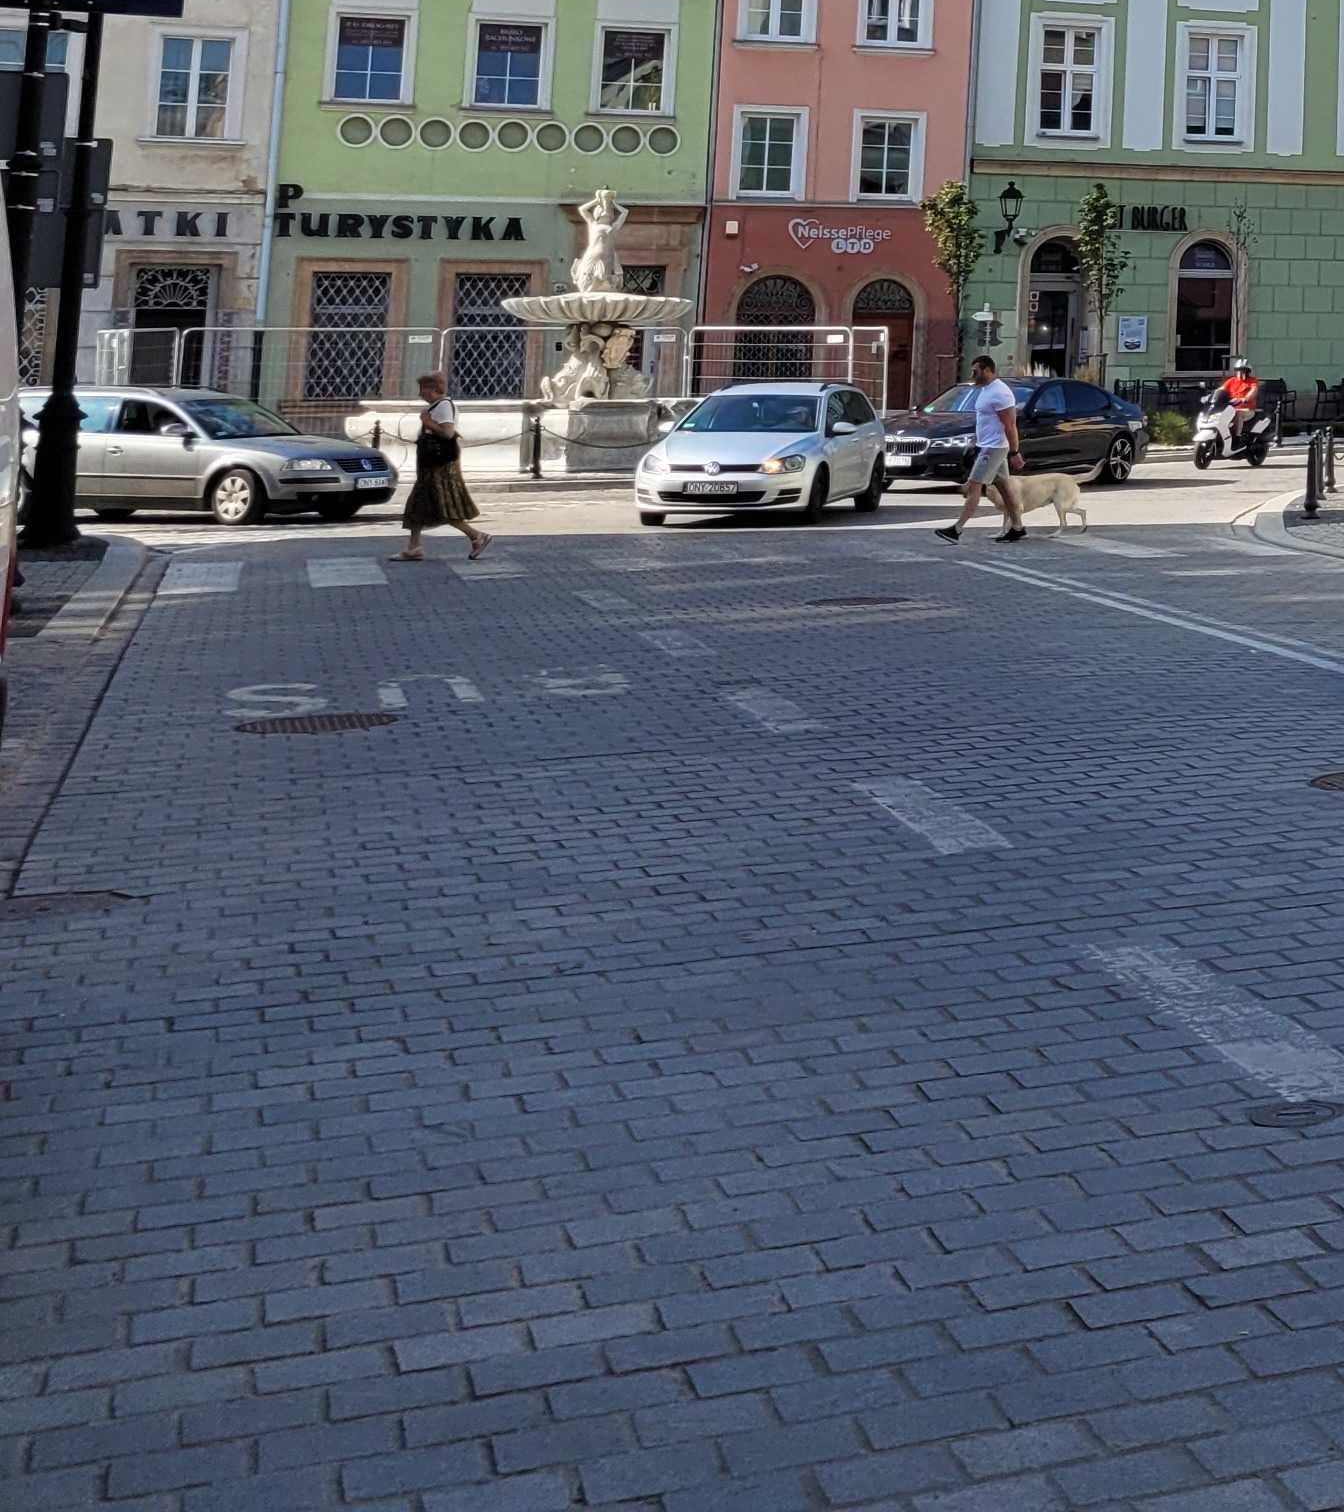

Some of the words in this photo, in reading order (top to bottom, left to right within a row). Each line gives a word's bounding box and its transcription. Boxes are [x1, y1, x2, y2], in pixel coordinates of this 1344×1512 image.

[275, 213, 526, 240] TURYSTYKA
[1132, 206, 1188, 231] BURGER
[834, 240, 873, 253] LTD
